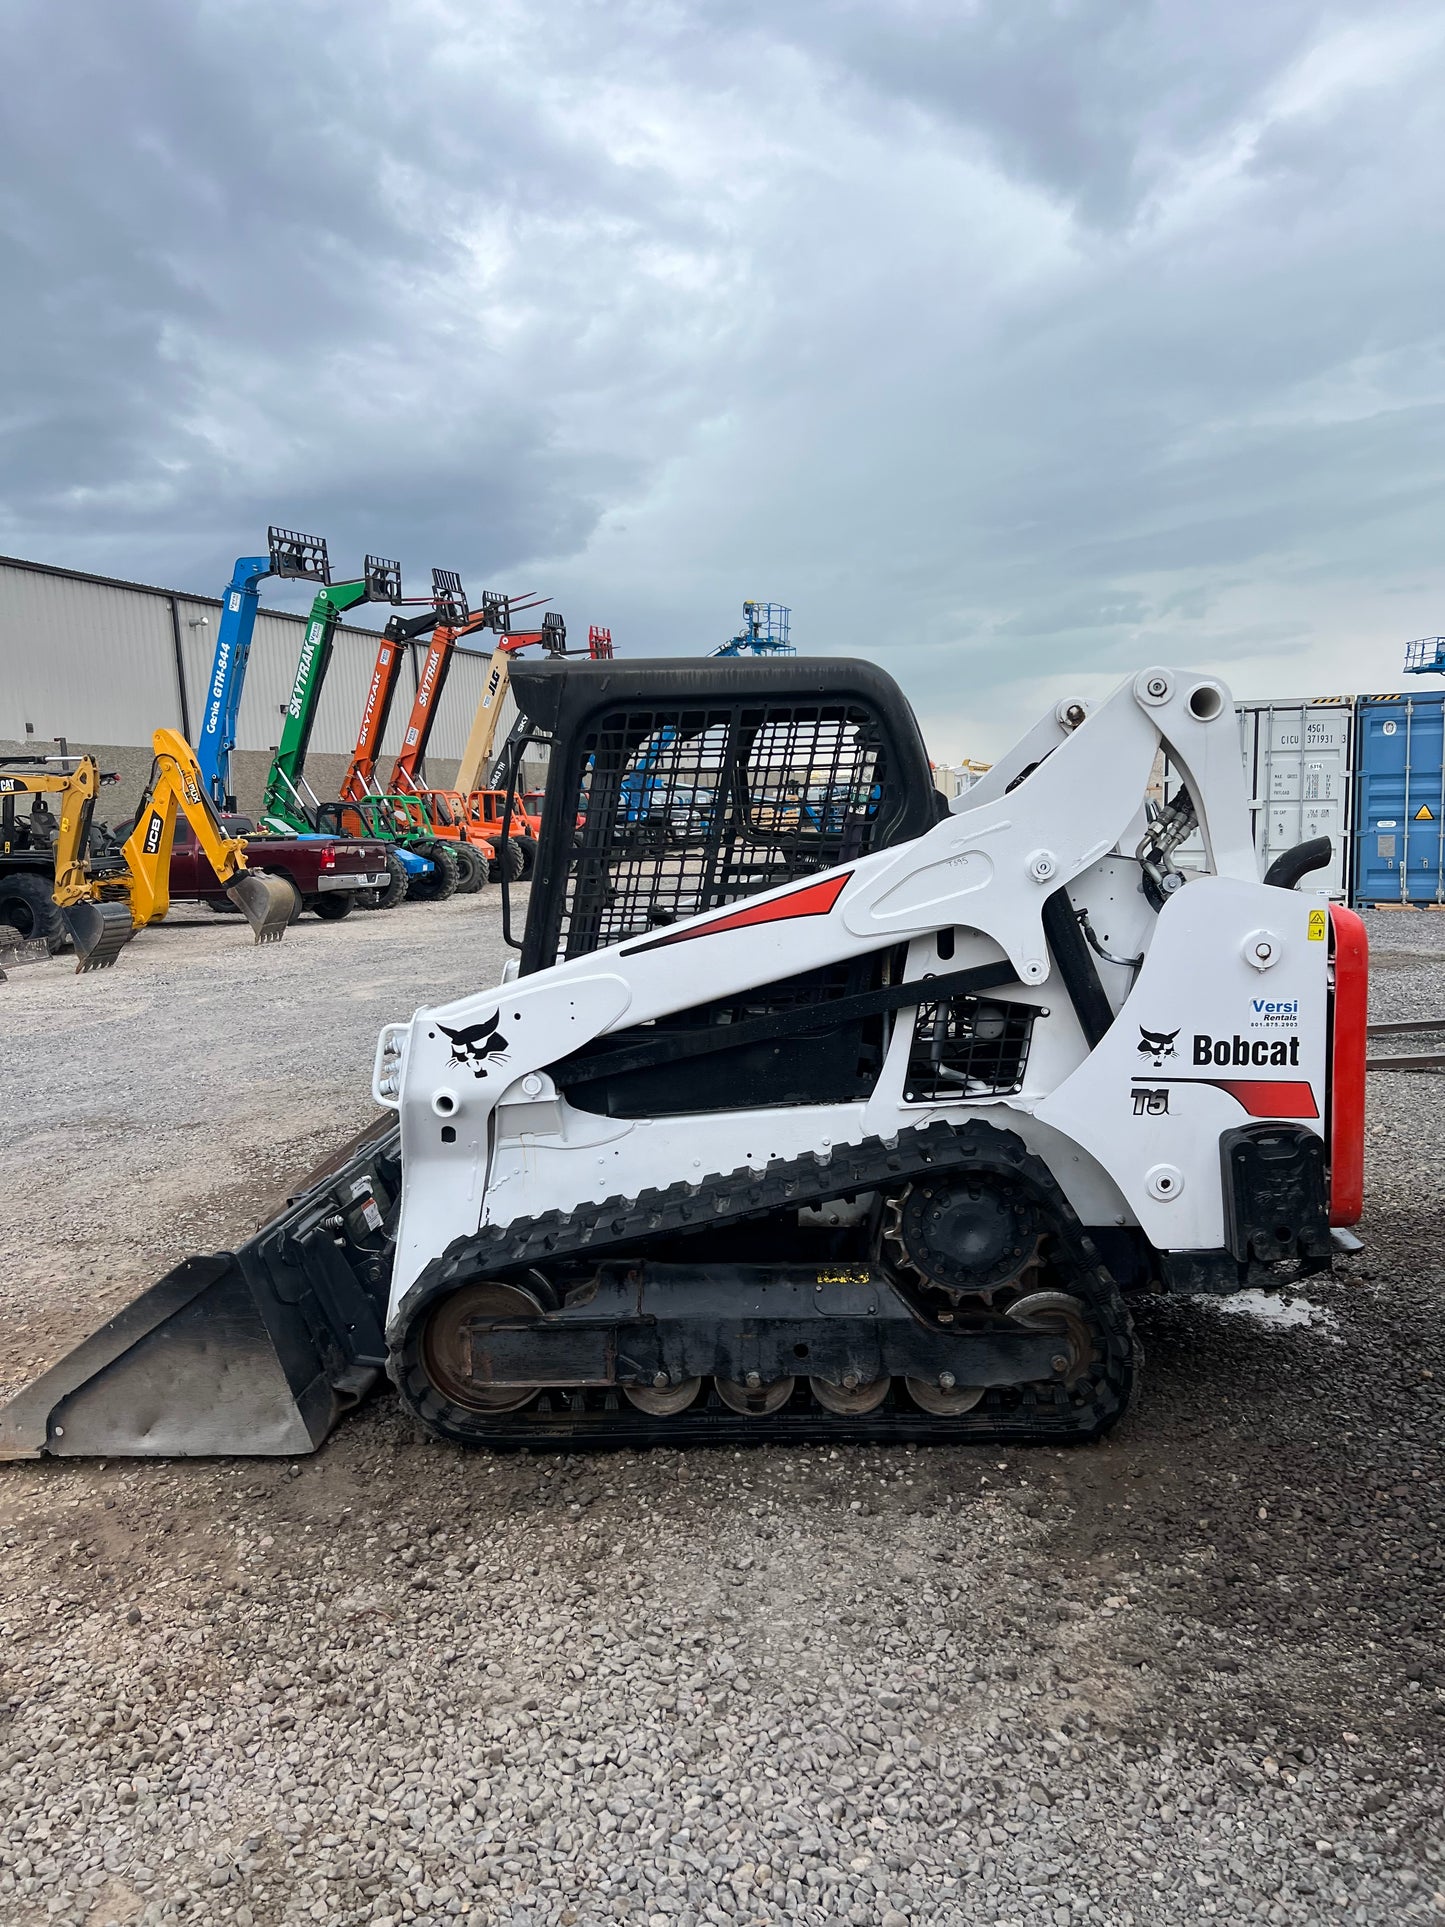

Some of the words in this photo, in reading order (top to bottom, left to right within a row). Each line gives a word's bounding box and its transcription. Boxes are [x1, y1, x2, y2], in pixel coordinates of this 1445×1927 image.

[310, 623, 318, 641] Versi
[212, 642, 231, 698] GTH-844
[289, 640, 315, 719] SKYTRAK
[419, 649, 440, 708] SKYTRAK
[487, 669, 501, 696] JLG
[206, 701, 220, 734] Genie
[360, 671, 381, 747] SKYTRAK
[1281, 736, 1299, 744] CICU
[1307, 735, 1333, 744] 371931
[1342, 735, 1347, 744] 3
[0, 779, 15, 792] CAT
[147, 818, 161, 853] JCB
[1253, 1000, 1298, 1012] Versi
[1193, 1035, 1300, 1066] Bobcat
